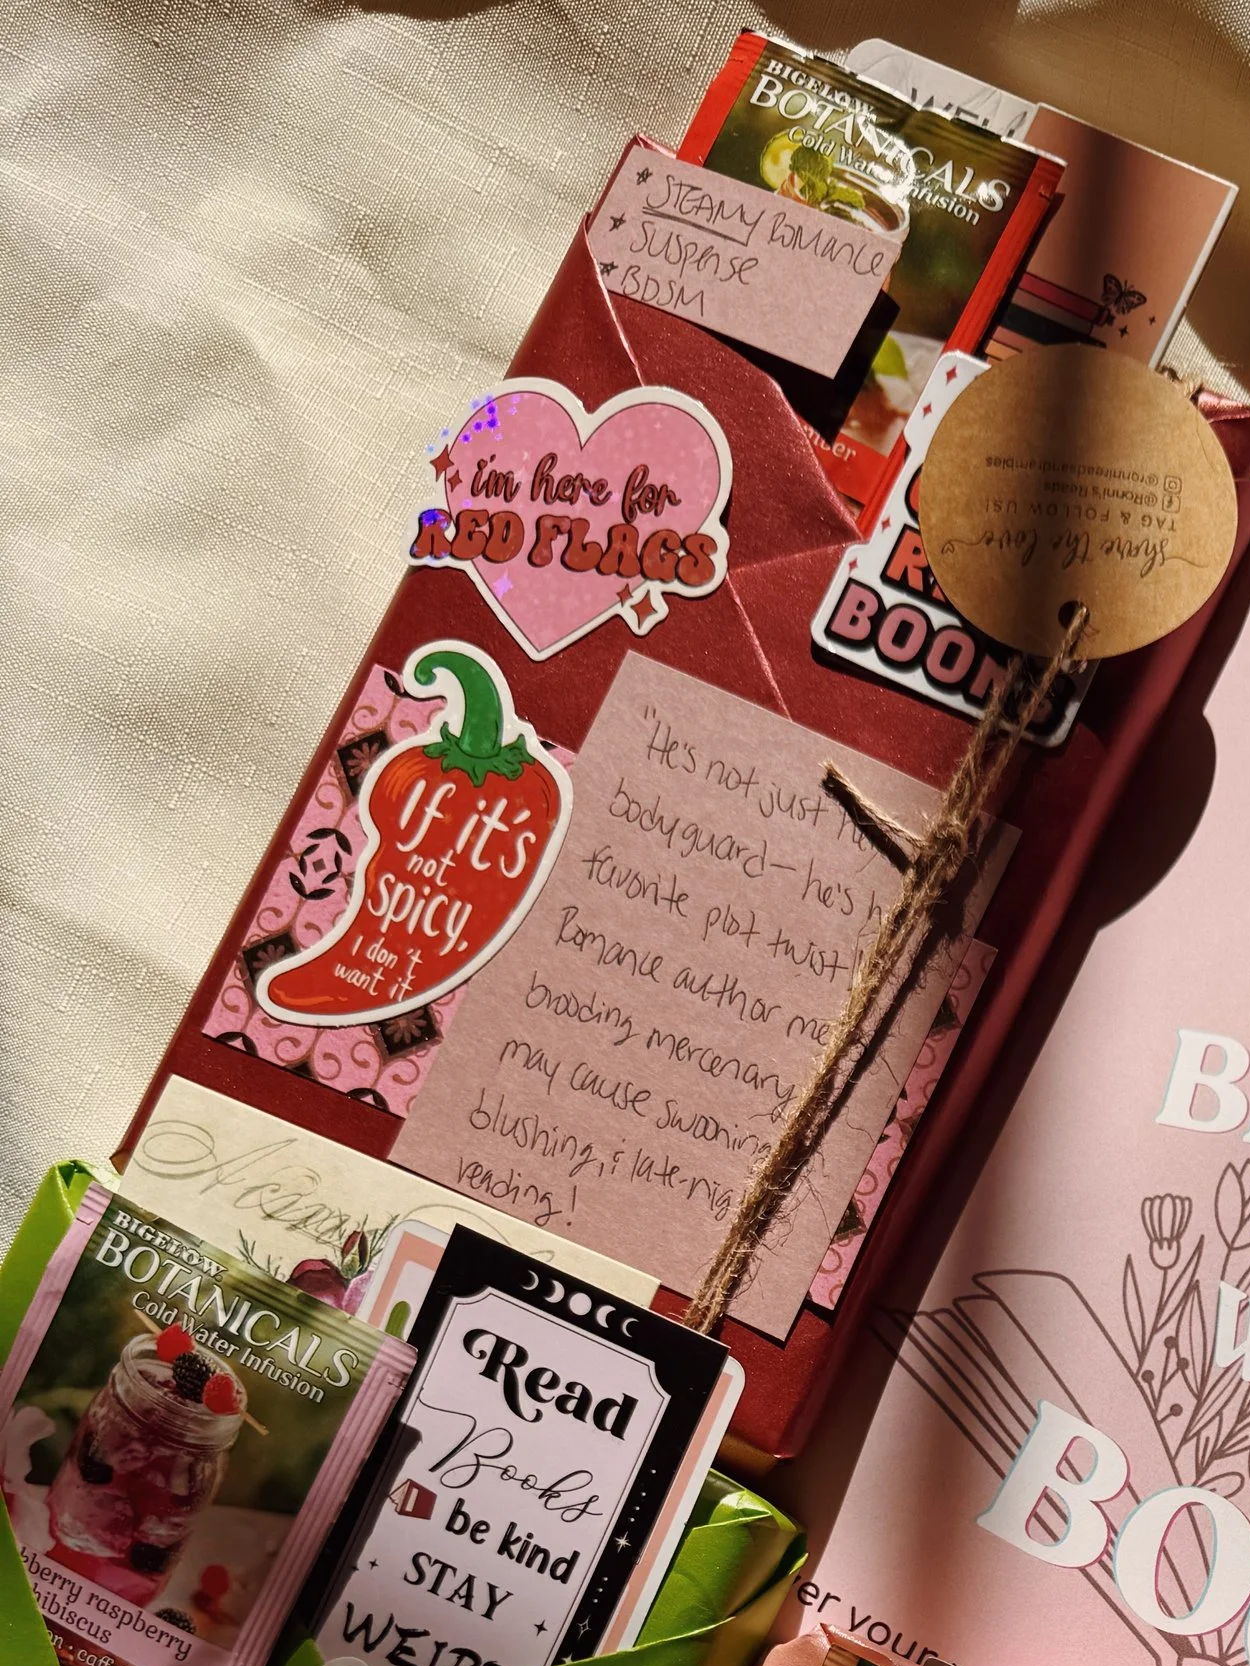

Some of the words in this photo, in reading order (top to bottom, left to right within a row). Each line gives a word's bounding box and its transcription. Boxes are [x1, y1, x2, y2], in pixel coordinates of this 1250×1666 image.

[645, 175, 766, 237] STEAMY
[621, 265, 705, 316] BDSM
[531, 453, 613, 506] here
[621, 464, 681, 523] for
[985, 498, 1019, 515] US!
[1029, 500, 1110, 522] FOLLOW
[1120, 510, 1132, 525] &
[410, 509, 524, 563] RED
[528, 514, 718, 587] FLAGS
[984, 528, 1038, 568] love
[1049, 528, 1095, 570] the
[1141, 513, 1177, 532] TAG
[1100, 536, 1169, 579] share
[396, 779, 457, 852] If
[457, 798, 536, 879] it's
[407, 850, 457, 887] not
[581, 845, 691, 919] favorite
[702, 906, 761, 941] plot
[367, 873, 474, 957] spicy,
[334, 964, 389, 997] want
[389, 978, 413, 1002] it
[352, 936, 363, 956] I
[367, 937, 423, 980] don't
[95, 1228, 359, 1391] BOTANICALS
[132, 1290, 179, 1327] Cold
[180, 1315, 240, 1358] Water
[240, 1346, 326, 1404] Infusion
[461, 1327, 639, 1443] Read
[423, 1399, 604, 1523] Books
[444, 1497, 491, 1545] be
[496, 1521, 581, 1585] kind
[32, 1582, 112, 1644] hibiscus
[403, 1551, 514, 1622] STAY
[86, 1590, 192, 1662] raspberry
